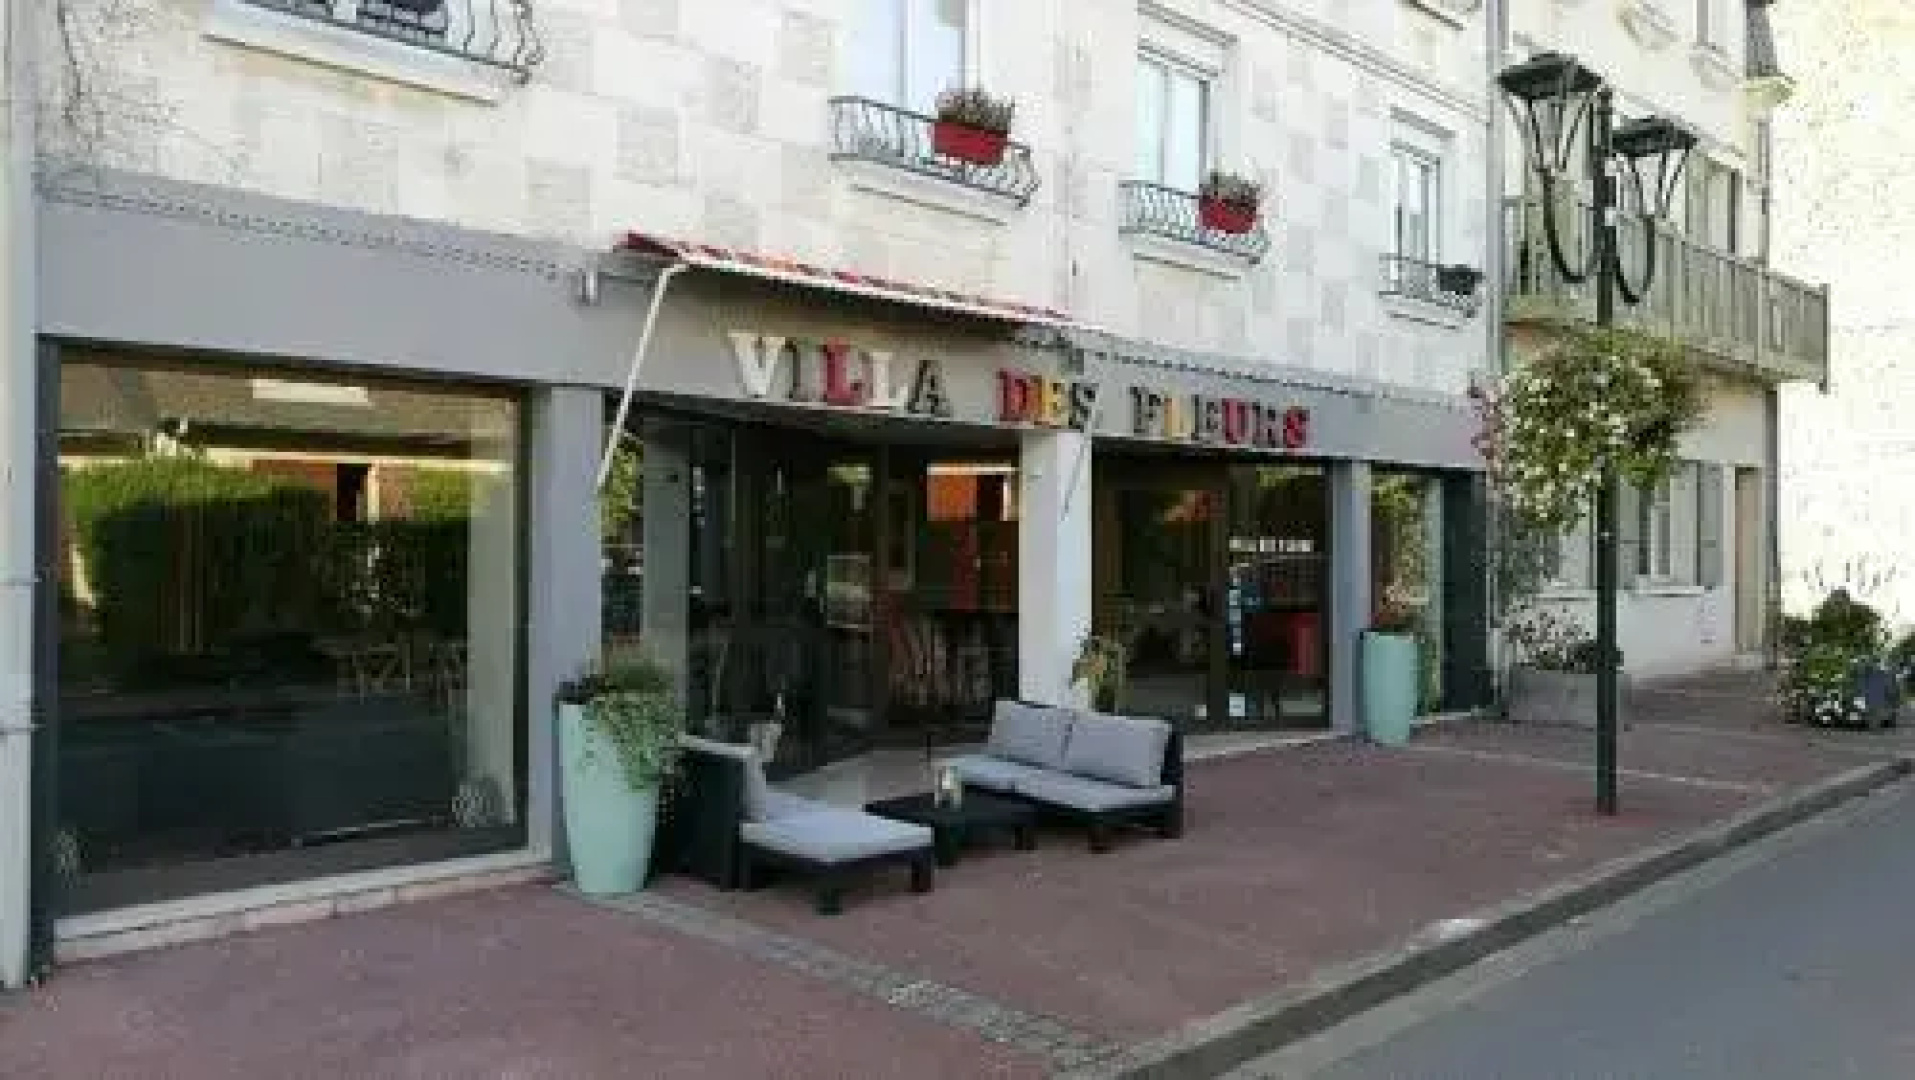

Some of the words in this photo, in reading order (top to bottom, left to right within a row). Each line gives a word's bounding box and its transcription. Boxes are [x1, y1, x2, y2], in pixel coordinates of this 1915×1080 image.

[728, 329, 952, 418] VILLA
[996, 370, 1098, 430] DES
[1130, 386, 1310, 449] FLEURS
